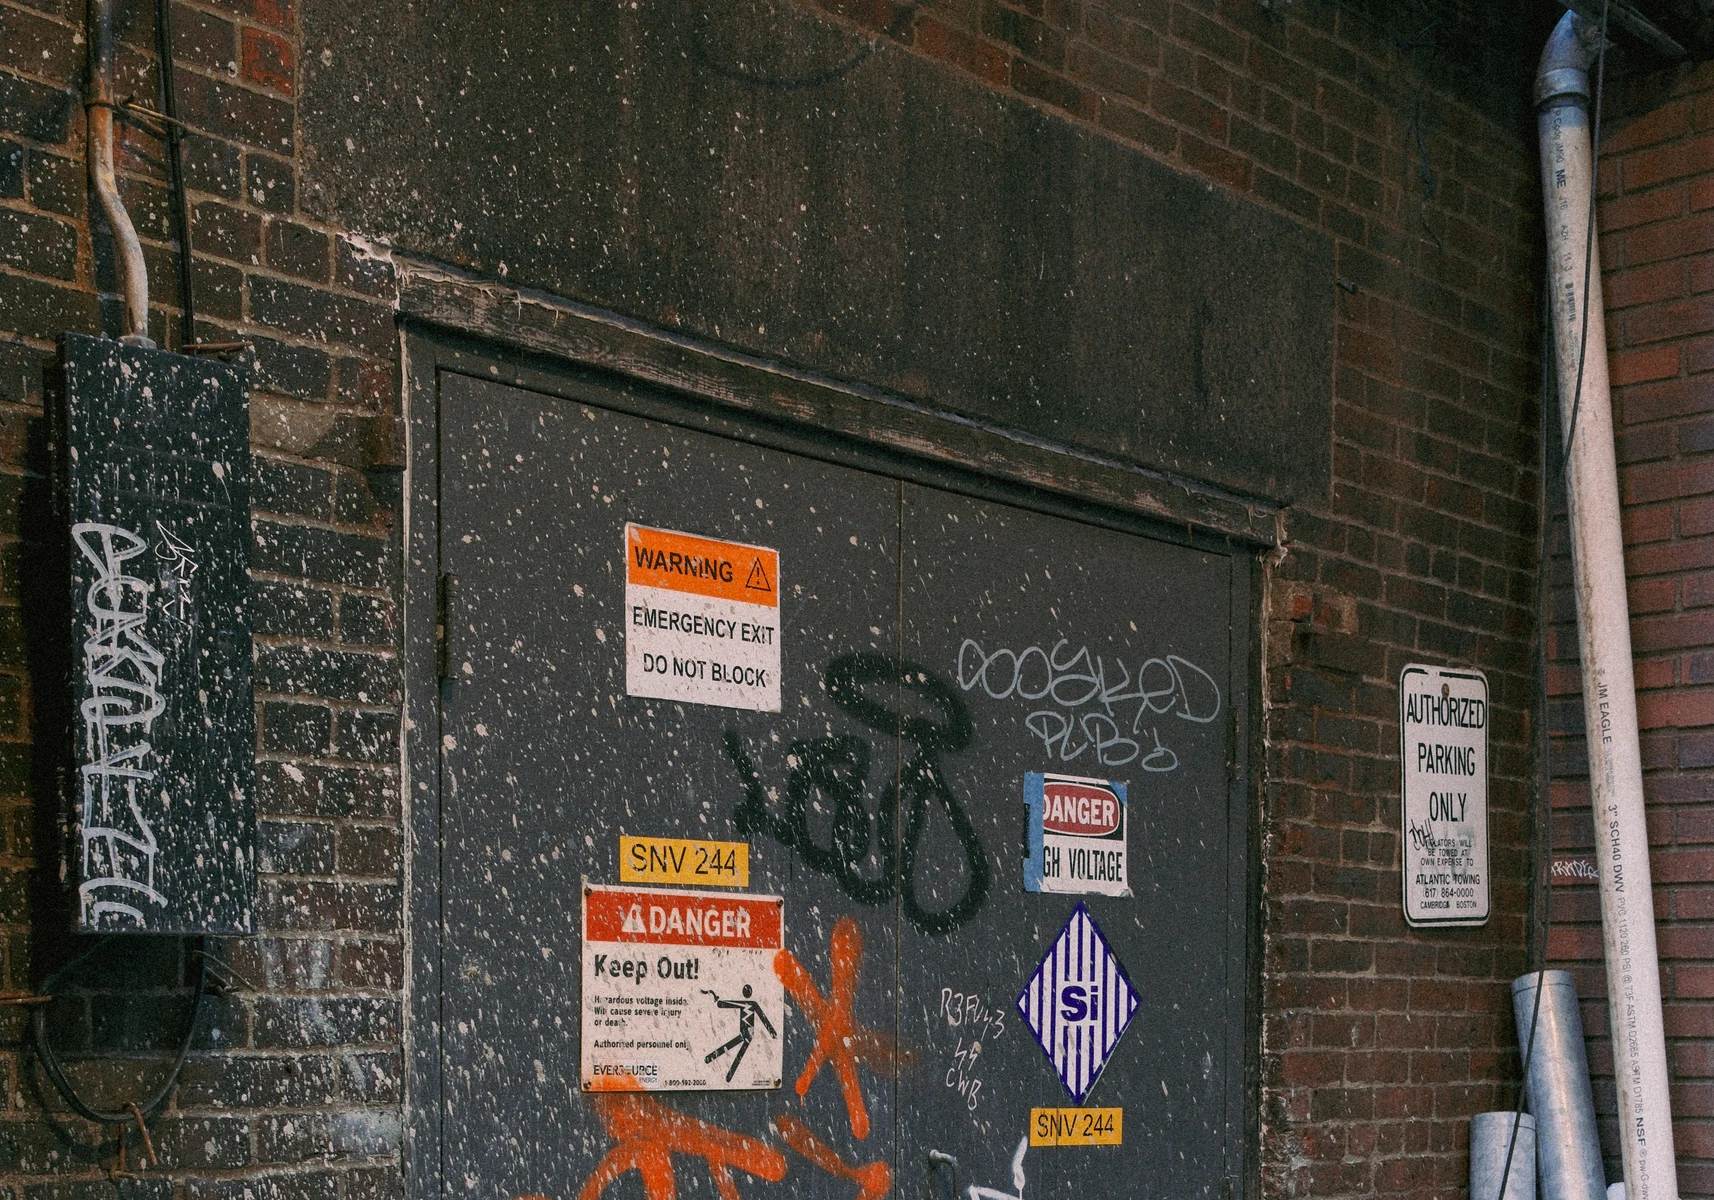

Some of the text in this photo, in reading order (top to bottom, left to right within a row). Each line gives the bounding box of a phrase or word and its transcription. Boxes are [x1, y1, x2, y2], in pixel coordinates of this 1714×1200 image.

[1554, 141, 1564, 163] JM90
[1555, 169, 1566, 188] ME
[634, 546, 734, 583] WARNING
[633, 606, 774, 646] EMERGENCY EXIT
[643, 653, 766, 688] DO NOT BLOCK
[1598, 682, 1608, 699] JM
[1406, 693, 1485, 729] AUTHORIZED
[1599, 702, 1612, 744] EAGLE
[1417, 742, 1475, 776] PARKING
[1429, 791, 1467, 822] ONLY
[1608, 804, 1618, 817] 3"
[1428, 848, 1435, 856] BE
[1610, 821, 1622, 861] SCH40
[631, 843, 736, 876] SNV 244
[1043, 846, 1123, 882] GH VOLTAGE
[1421, 857, 1474, 866] OWN EXPENSE TO
[1415, 873, 1480, 885] ATLANTIC TOWING
[1613, 865, 1624, 893] DWV
[1441, 888, 1474, 898] 864-0000
[1456, 900, 1477, 909] BOSTON
[1617, 897, 1627, 916] PVC
[650, 905, 751, 939] DANGER
[1619, 918, 1628, 939] 1120
[1620, 941, 1629, 956] 260
[594, 954, 700, 985] Keep Out!
[1622, 958, 1631, 972] PSI
[594, 994, 634, 1005] Hardous
[636, 996, 663, 1007] voltage
[610, 1008, 632, 1016] cause
[1060, 985, 1098, 1022] Si
[604, 1017, 628, 1027] deah.
[1626, 1004, 1636, 1029] ASTM
[636, 1040, 673, 1050] personnel
[1628, 1031, 1639, 1058] D2665
[593, 1064, 658, 1076] EVERSOURCE
[1631, 1060, 1641, 1085] ASTM
[1633, 1087, 1644, 1114] D1785
[1037, 1113, 1115, 1138] SNV 244
[1635, 1117, 1646, 1147] NSF
